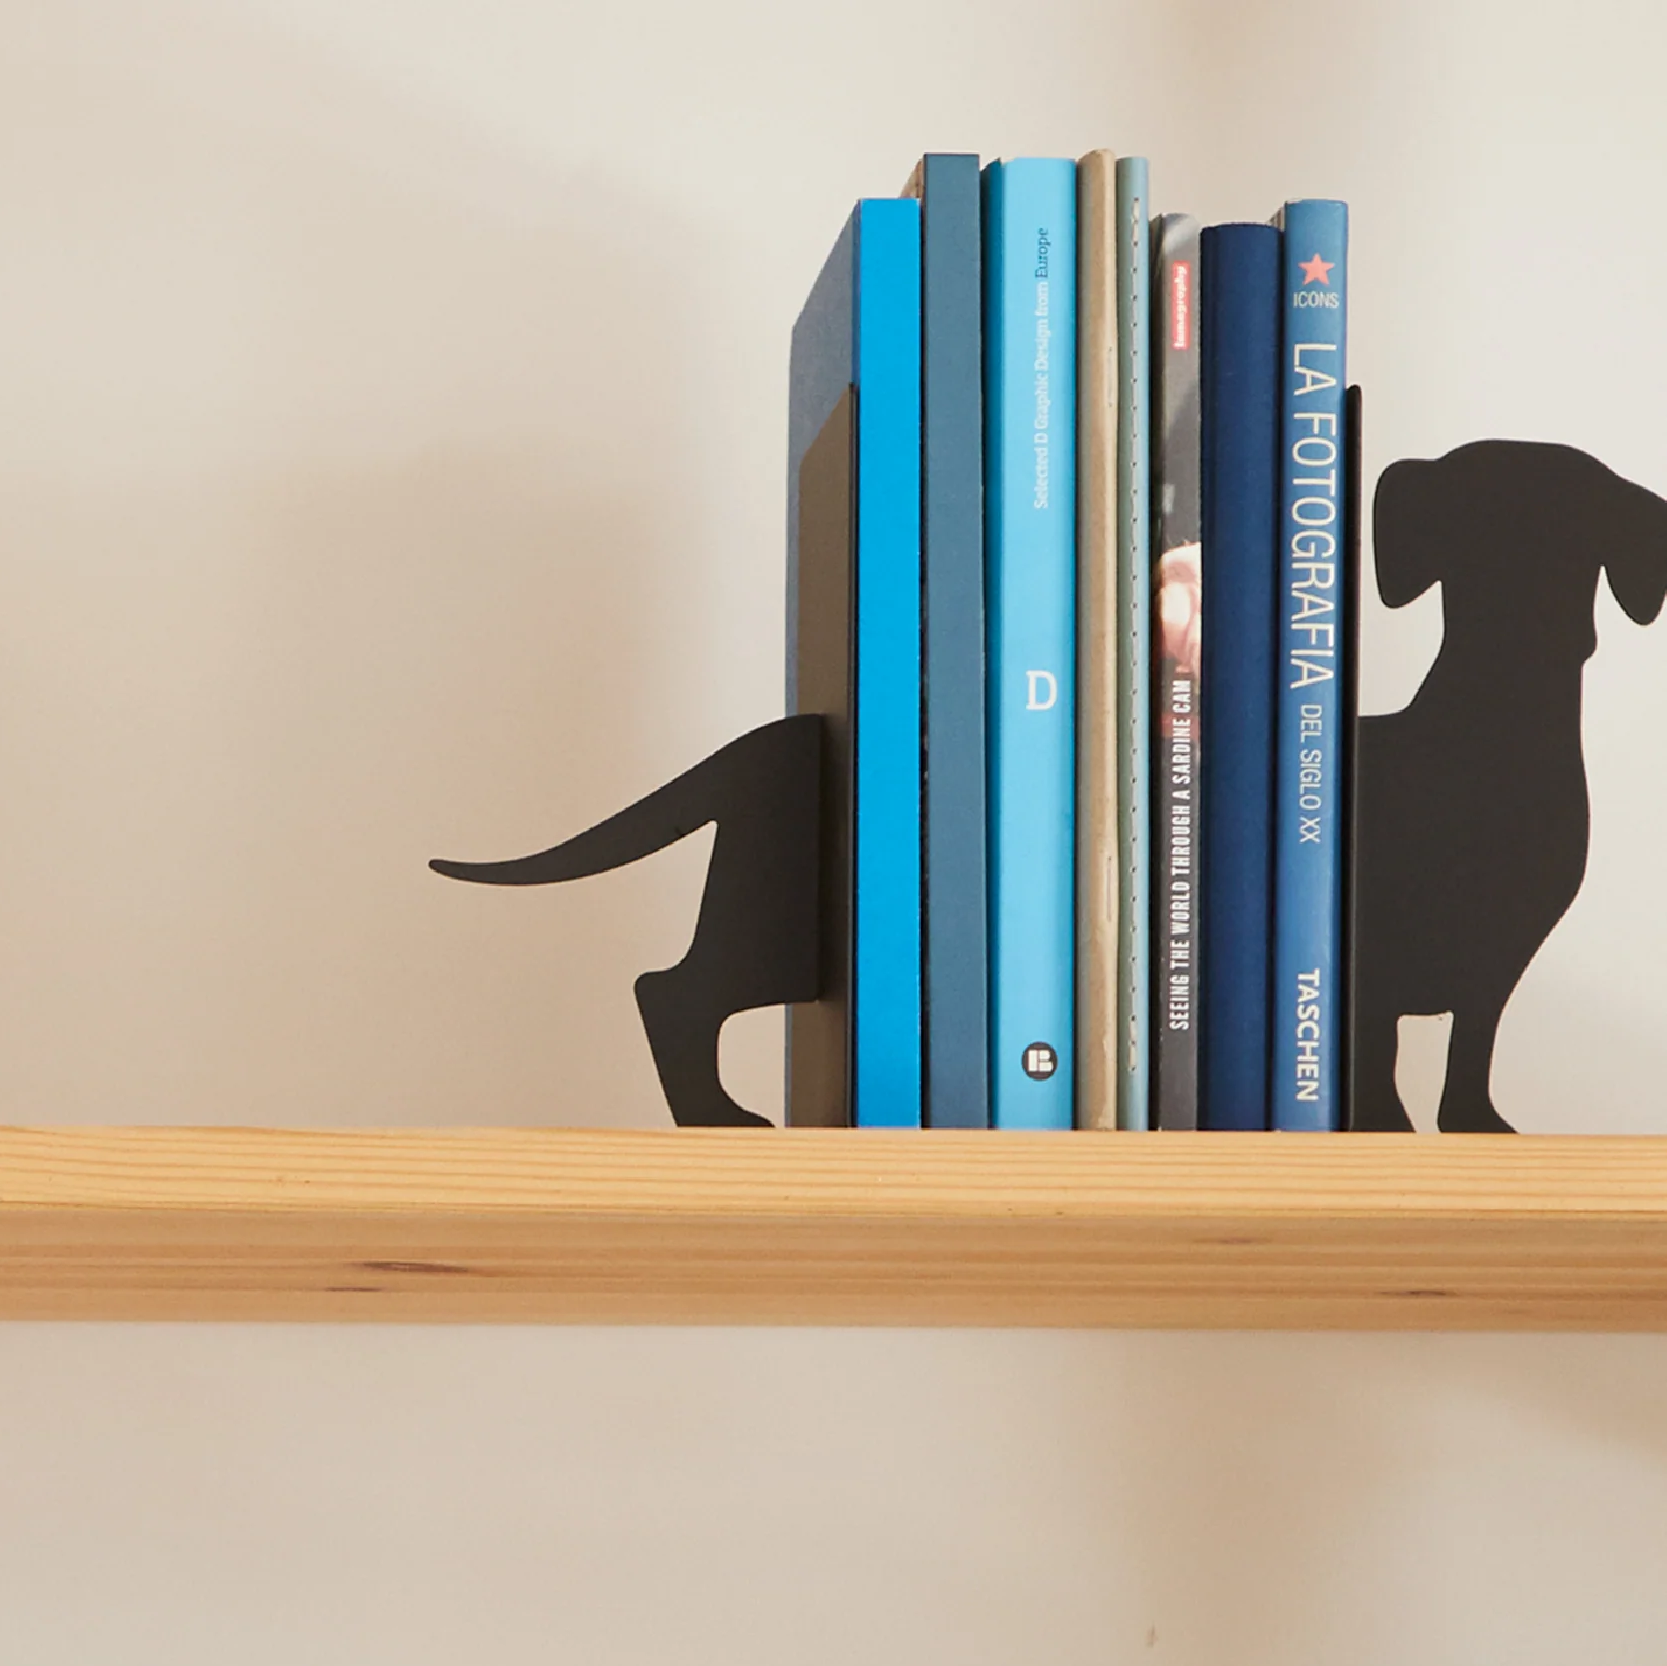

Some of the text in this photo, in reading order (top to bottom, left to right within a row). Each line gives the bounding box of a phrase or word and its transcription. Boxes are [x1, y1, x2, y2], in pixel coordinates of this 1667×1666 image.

[1033, 227, 1052, 509] Selected D Graphic Design from Europe
[1293, 291, 1340, 308] ICONS
[1025, 669, 1058, 712] D
[1291, 343, 1337, 843] LA FOTOGRAFIA DEL SIGLO XX
[1169, 680, 1192, 1031] SEEING THE WORLD THROUGH A SARDINE CAN
[1296, 966, 1322, 1102] TASCHEN
